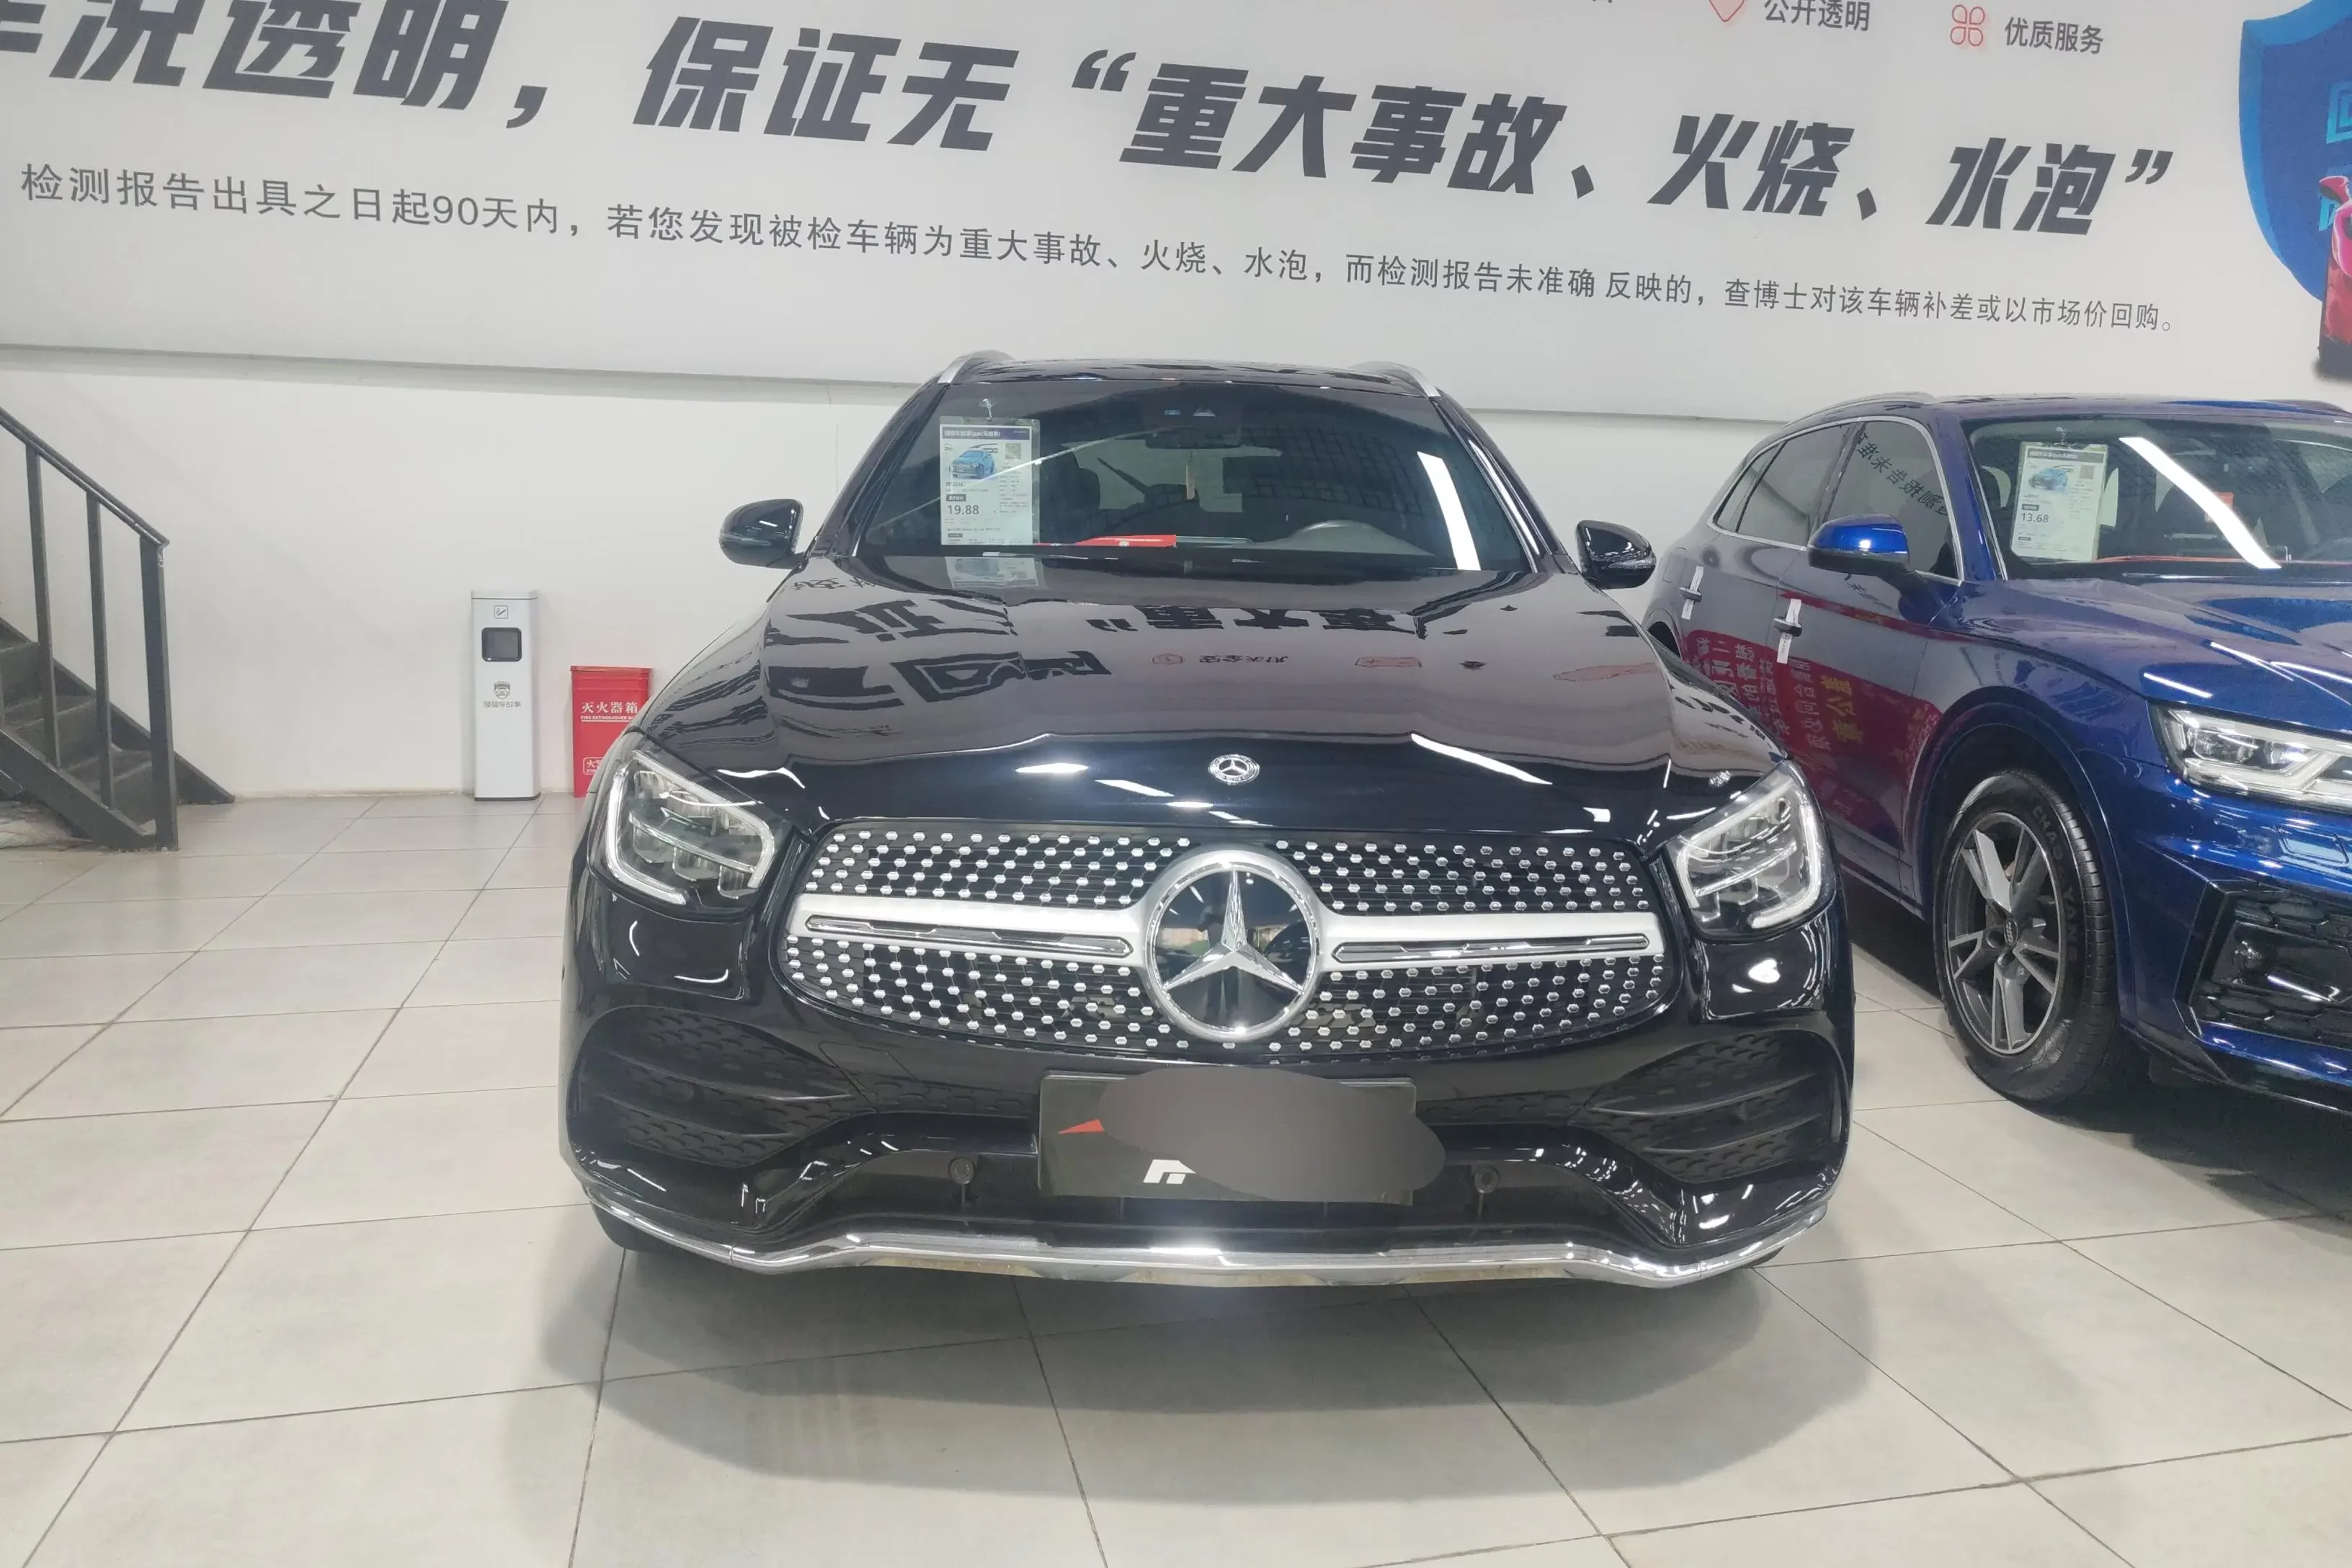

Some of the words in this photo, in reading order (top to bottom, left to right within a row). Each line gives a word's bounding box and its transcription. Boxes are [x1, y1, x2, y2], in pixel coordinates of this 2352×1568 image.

[1763, 0, 1871, 32] 公开透明
[2004, 17, 2105, 55] 优质服务
[947, 504, 979, 515] 19.88
[2021, 512, 2049, 523] 13.68
[582, 701, 638, 714] 灭火器箱
